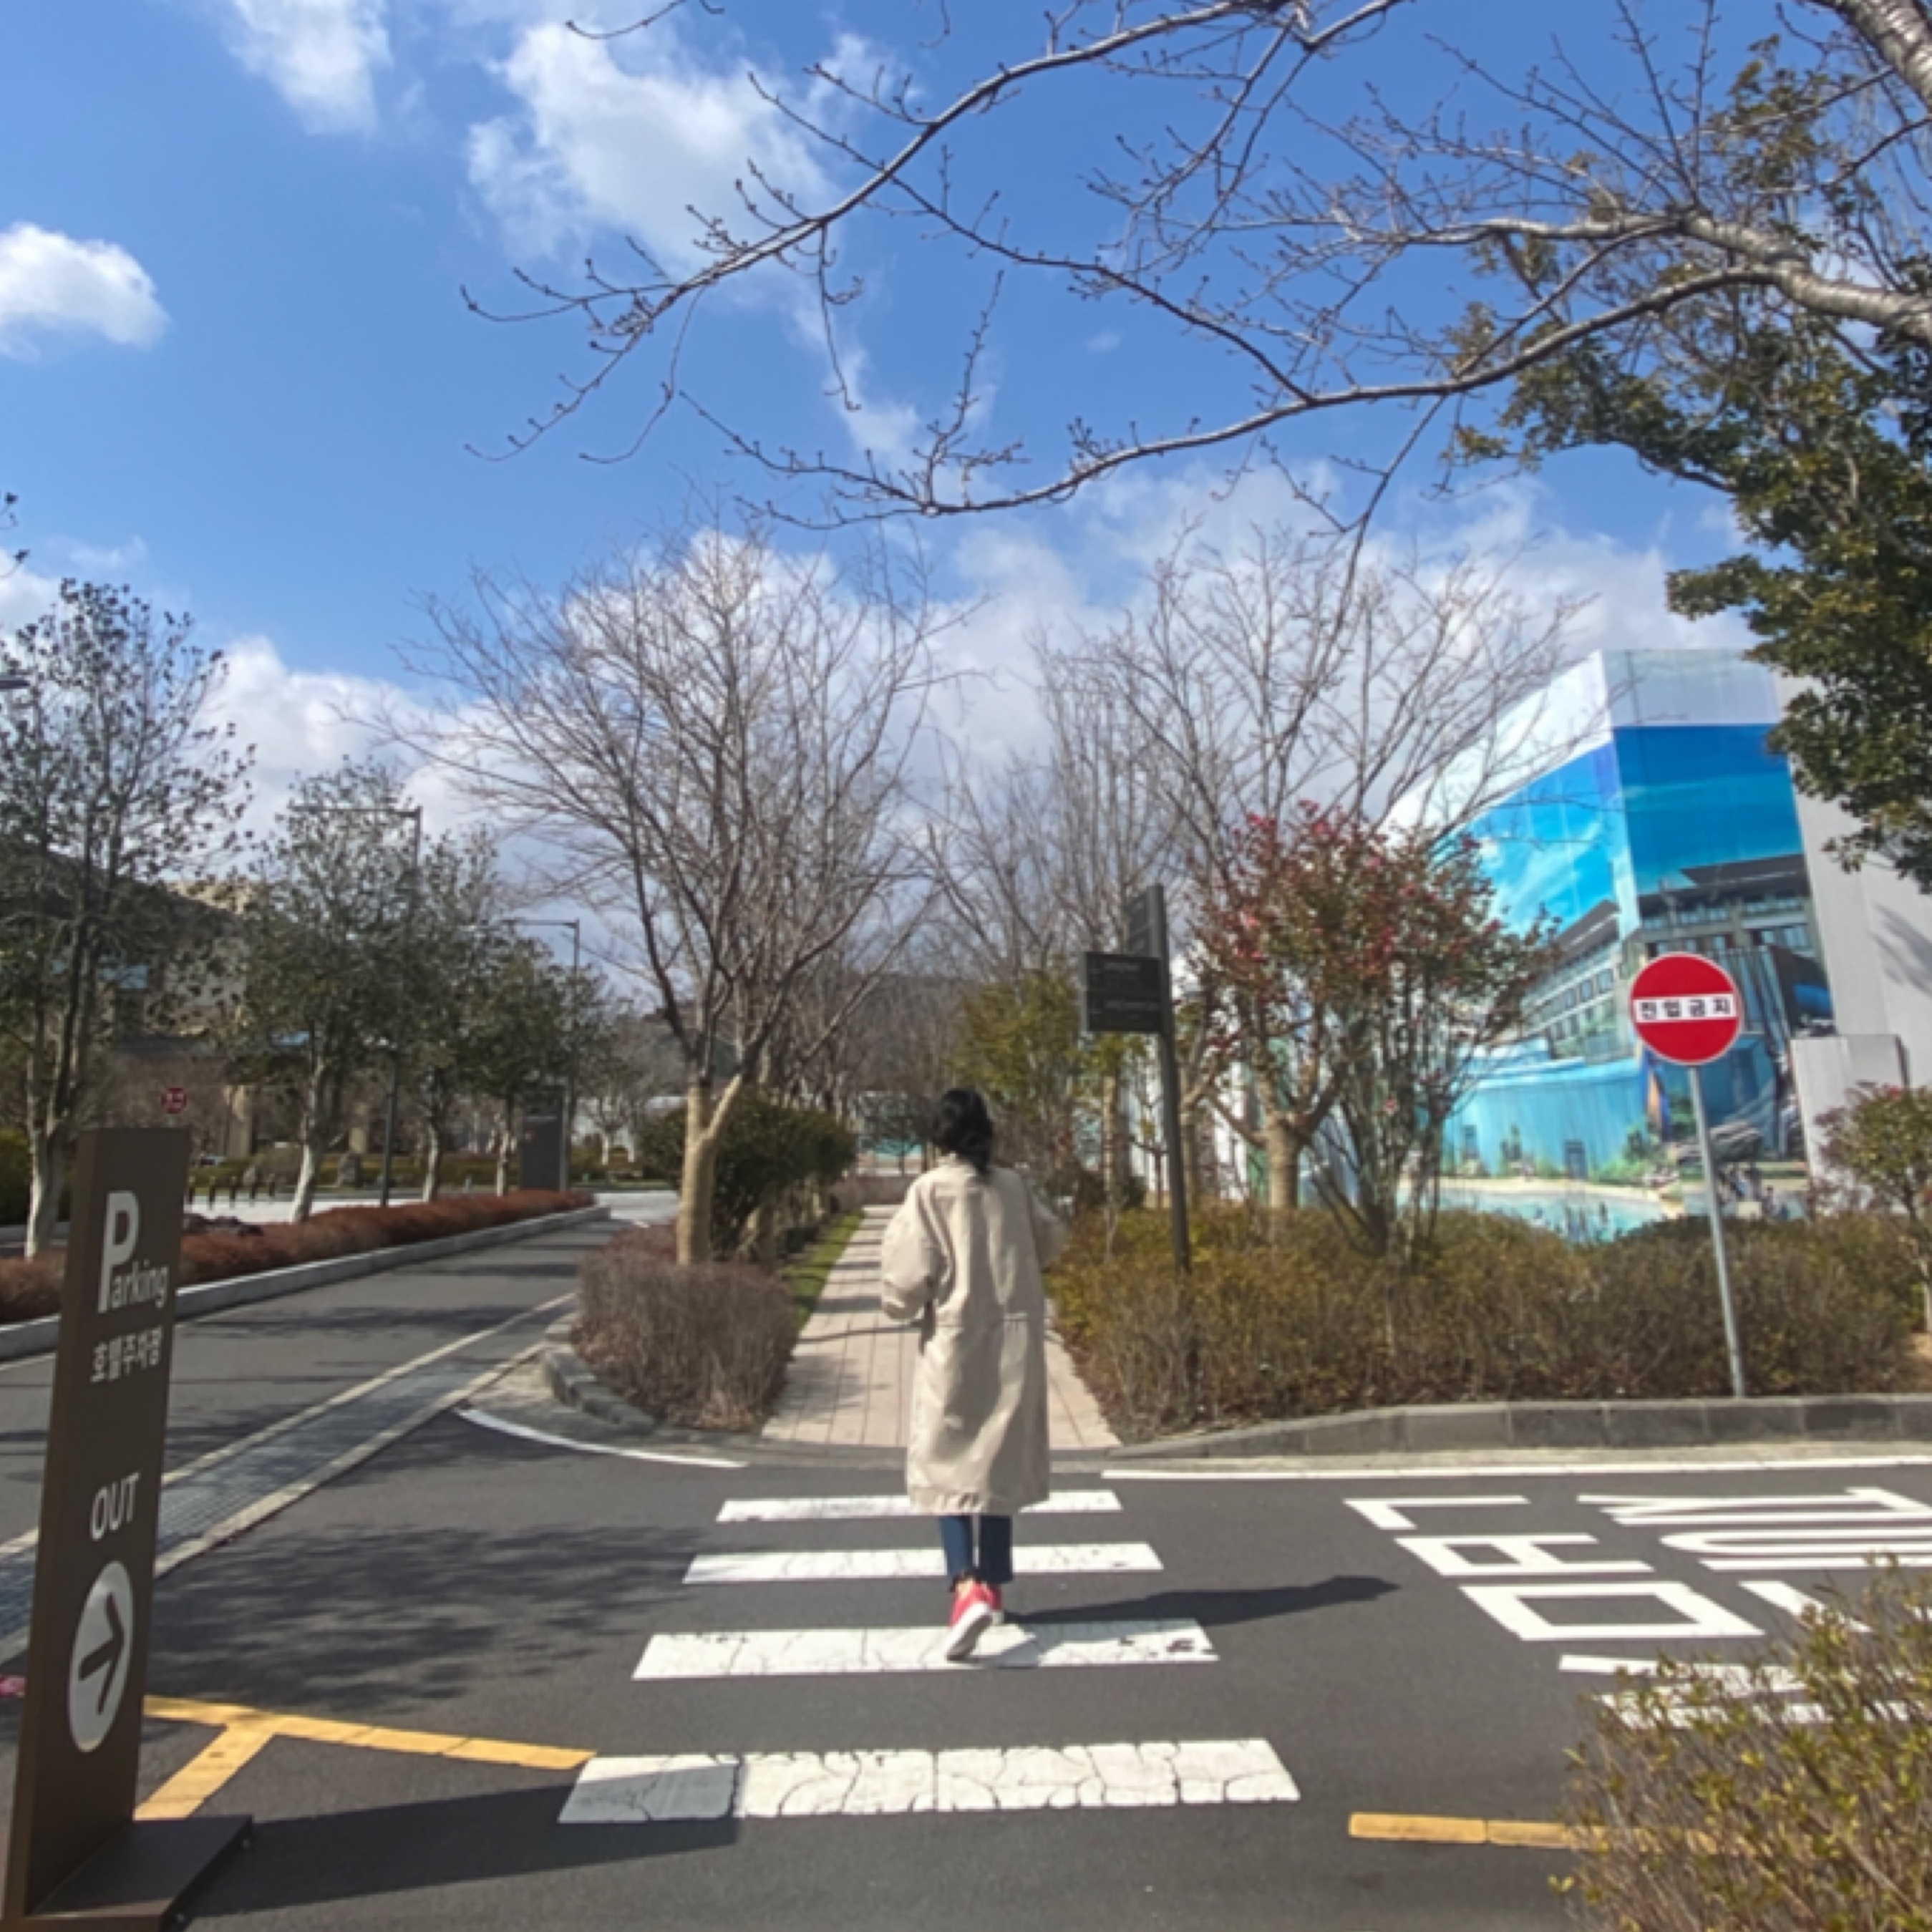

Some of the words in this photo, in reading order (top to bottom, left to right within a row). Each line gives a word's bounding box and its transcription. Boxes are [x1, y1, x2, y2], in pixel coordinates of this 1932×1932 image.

[1638, 996, 1732, 1020] 진입금지
[98, 1190, 169, 1314] Parking
[90, 1325, 163, 1382] 호텔주차장
[90, 1472, 140, 1542] OUT
